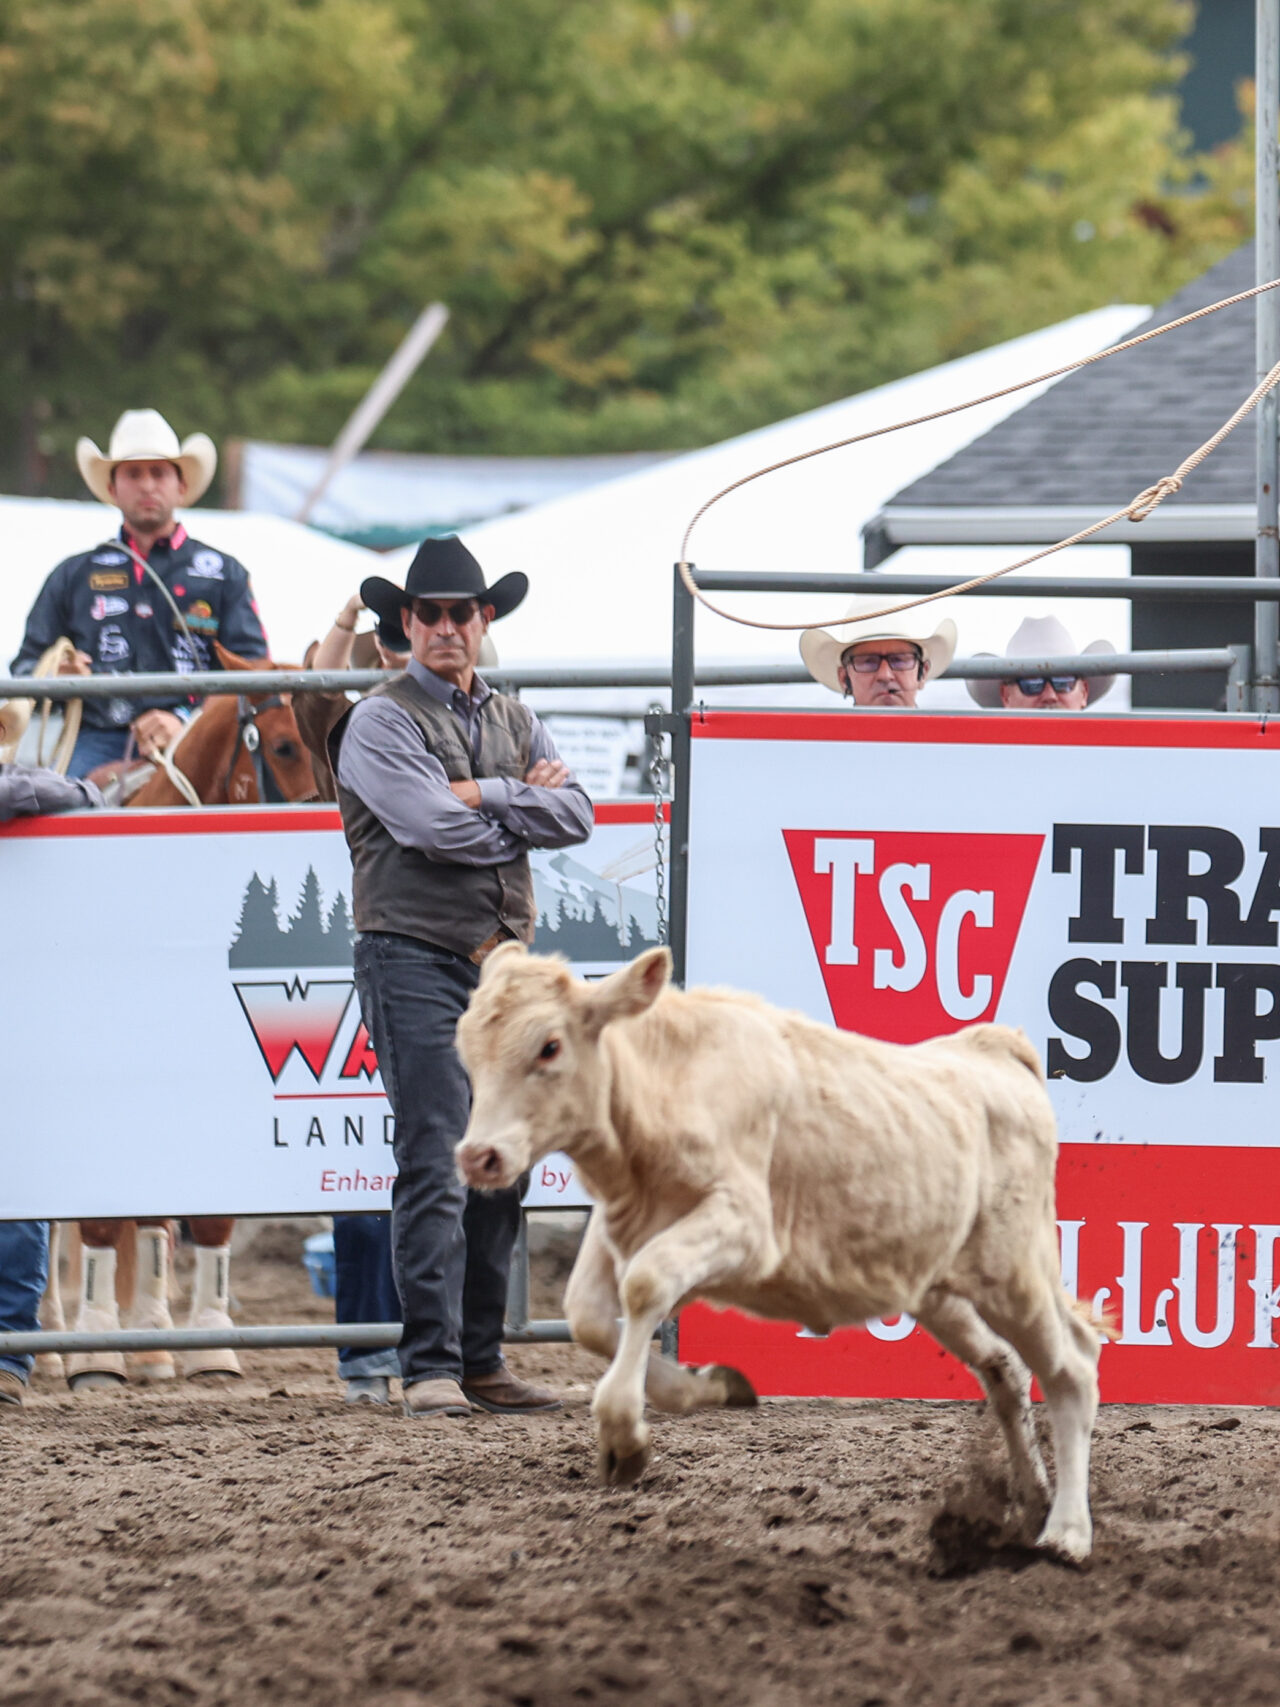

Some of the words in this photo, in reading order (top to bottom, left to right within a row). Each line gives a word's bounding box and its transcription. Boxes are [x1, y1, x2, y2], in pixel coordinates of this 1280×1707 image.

[813, 838, 994, 1021] TSC
[232, 974, 381, 1085] WA
[273, 1114, 396, 1148] LAND
[320, 1169, 398, 1193] Enhan
[541, 1165, 572, 1194] by
